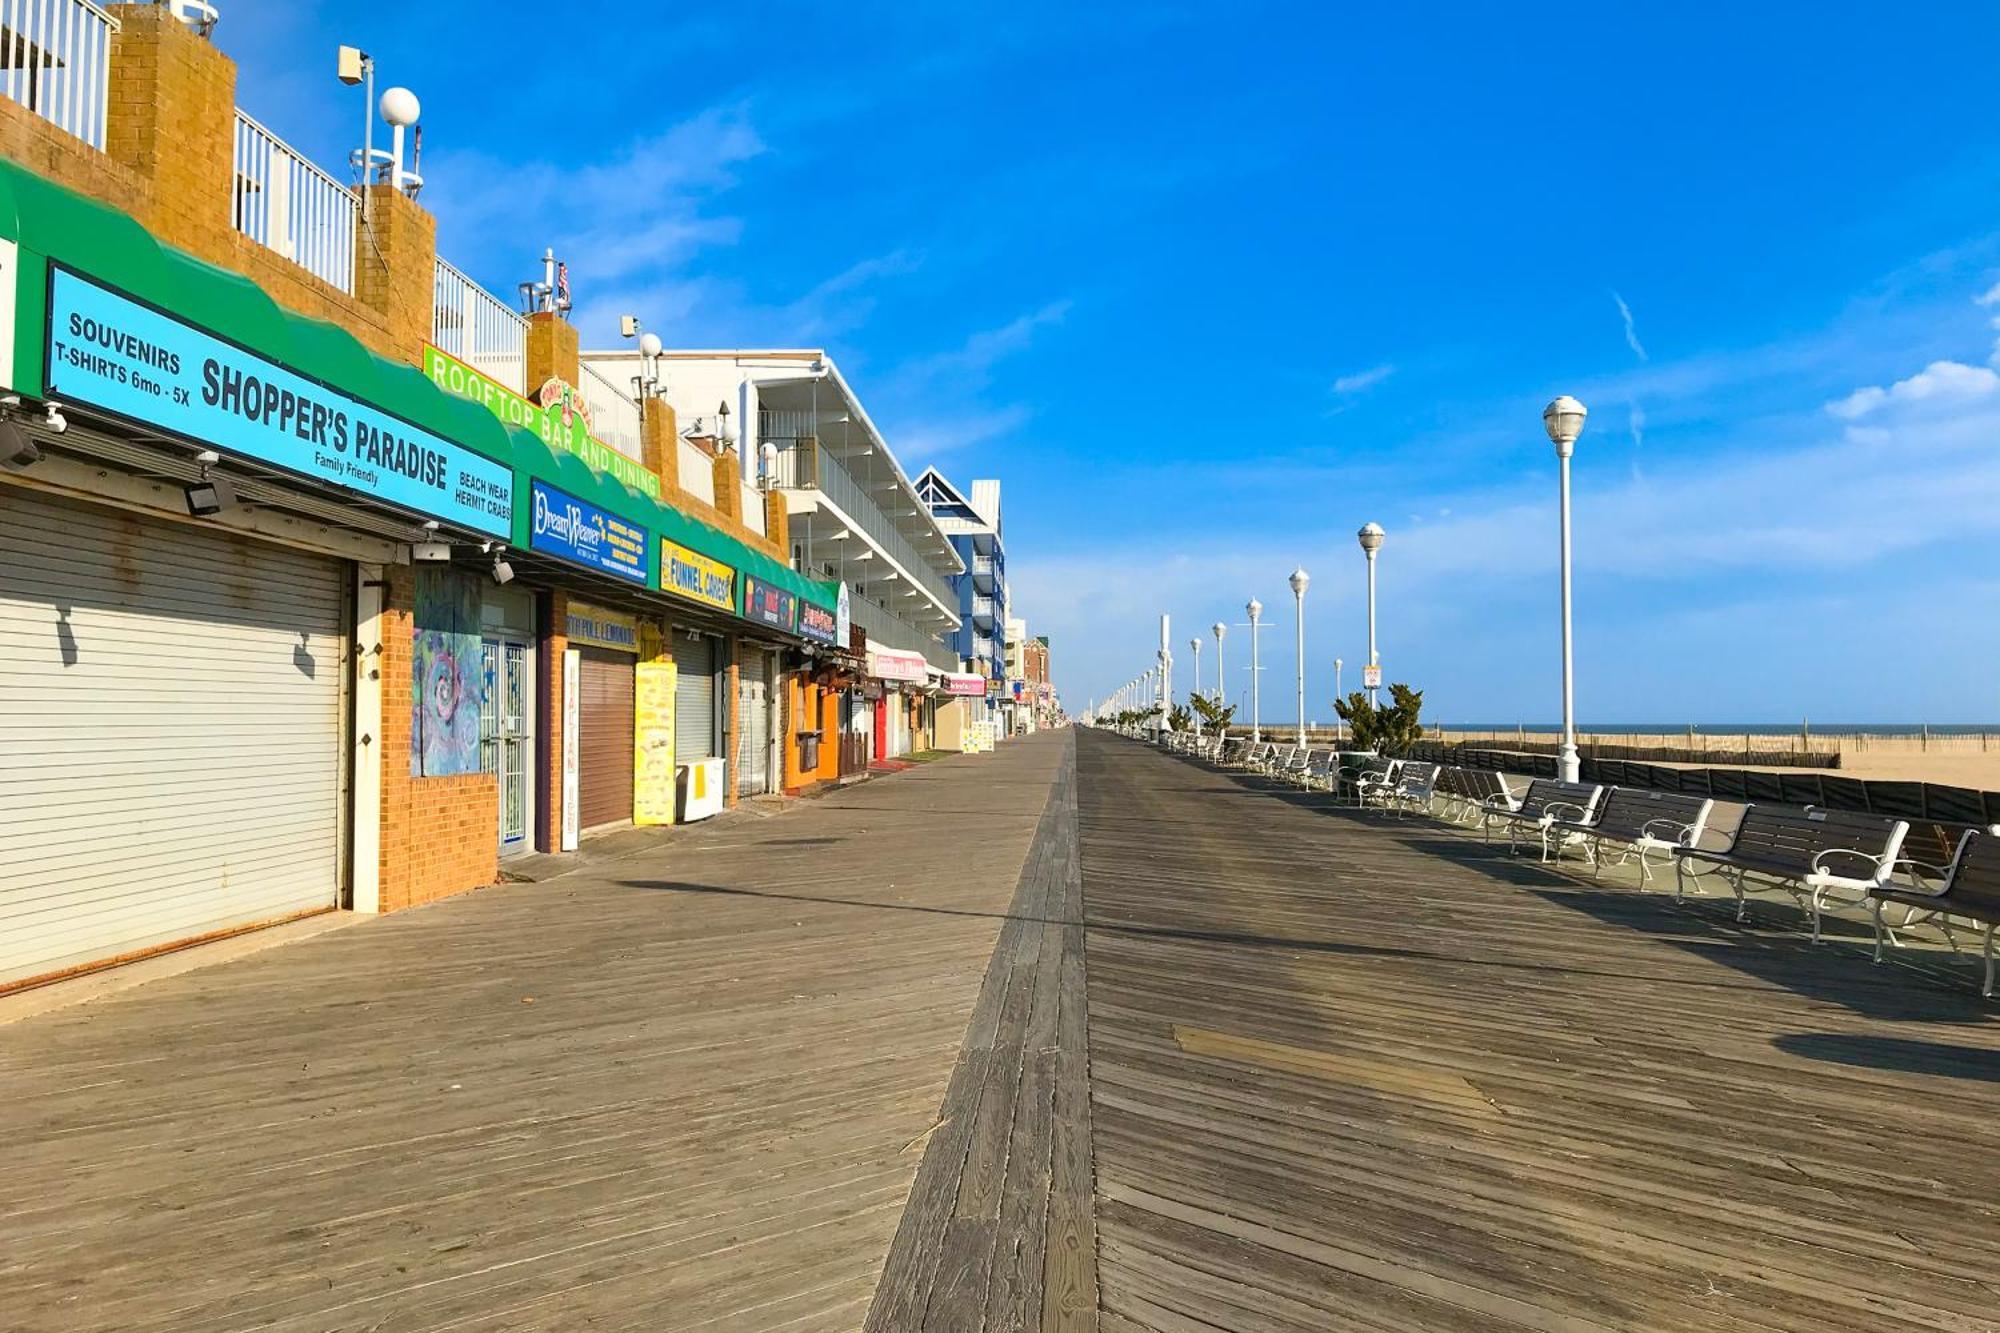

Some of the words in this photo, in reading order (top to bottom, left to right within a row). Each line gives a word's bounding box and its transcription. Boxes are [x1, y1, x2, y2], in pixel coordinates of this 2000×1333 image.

[55, 341, 127, 384] T-SHIRTS
[131, 371, 161, 396] 6mo
[172, 386, 190, 407] 5X
[69, 312, 180, 375] SOUVENIRS
[202, 358, 348, 453] SHOPPER'S
[356, 420, 448, 490] PARADISE
[432, 354, 534, 429] ROOFTOP
[541, 416, 573, 451] BAR
[580, 437, 610, 475] AND
[614, 460, 656, 497] DINING
[315, 452, 346, 475] Family
[346, 460, 379, 488] Friendly
[459, 471, 487, 494] BEACH
[487, 482, 509, 502] WEAR
[455, 488, 486, 514] HERMIT
[487, 501, 512, 521] CRABS
